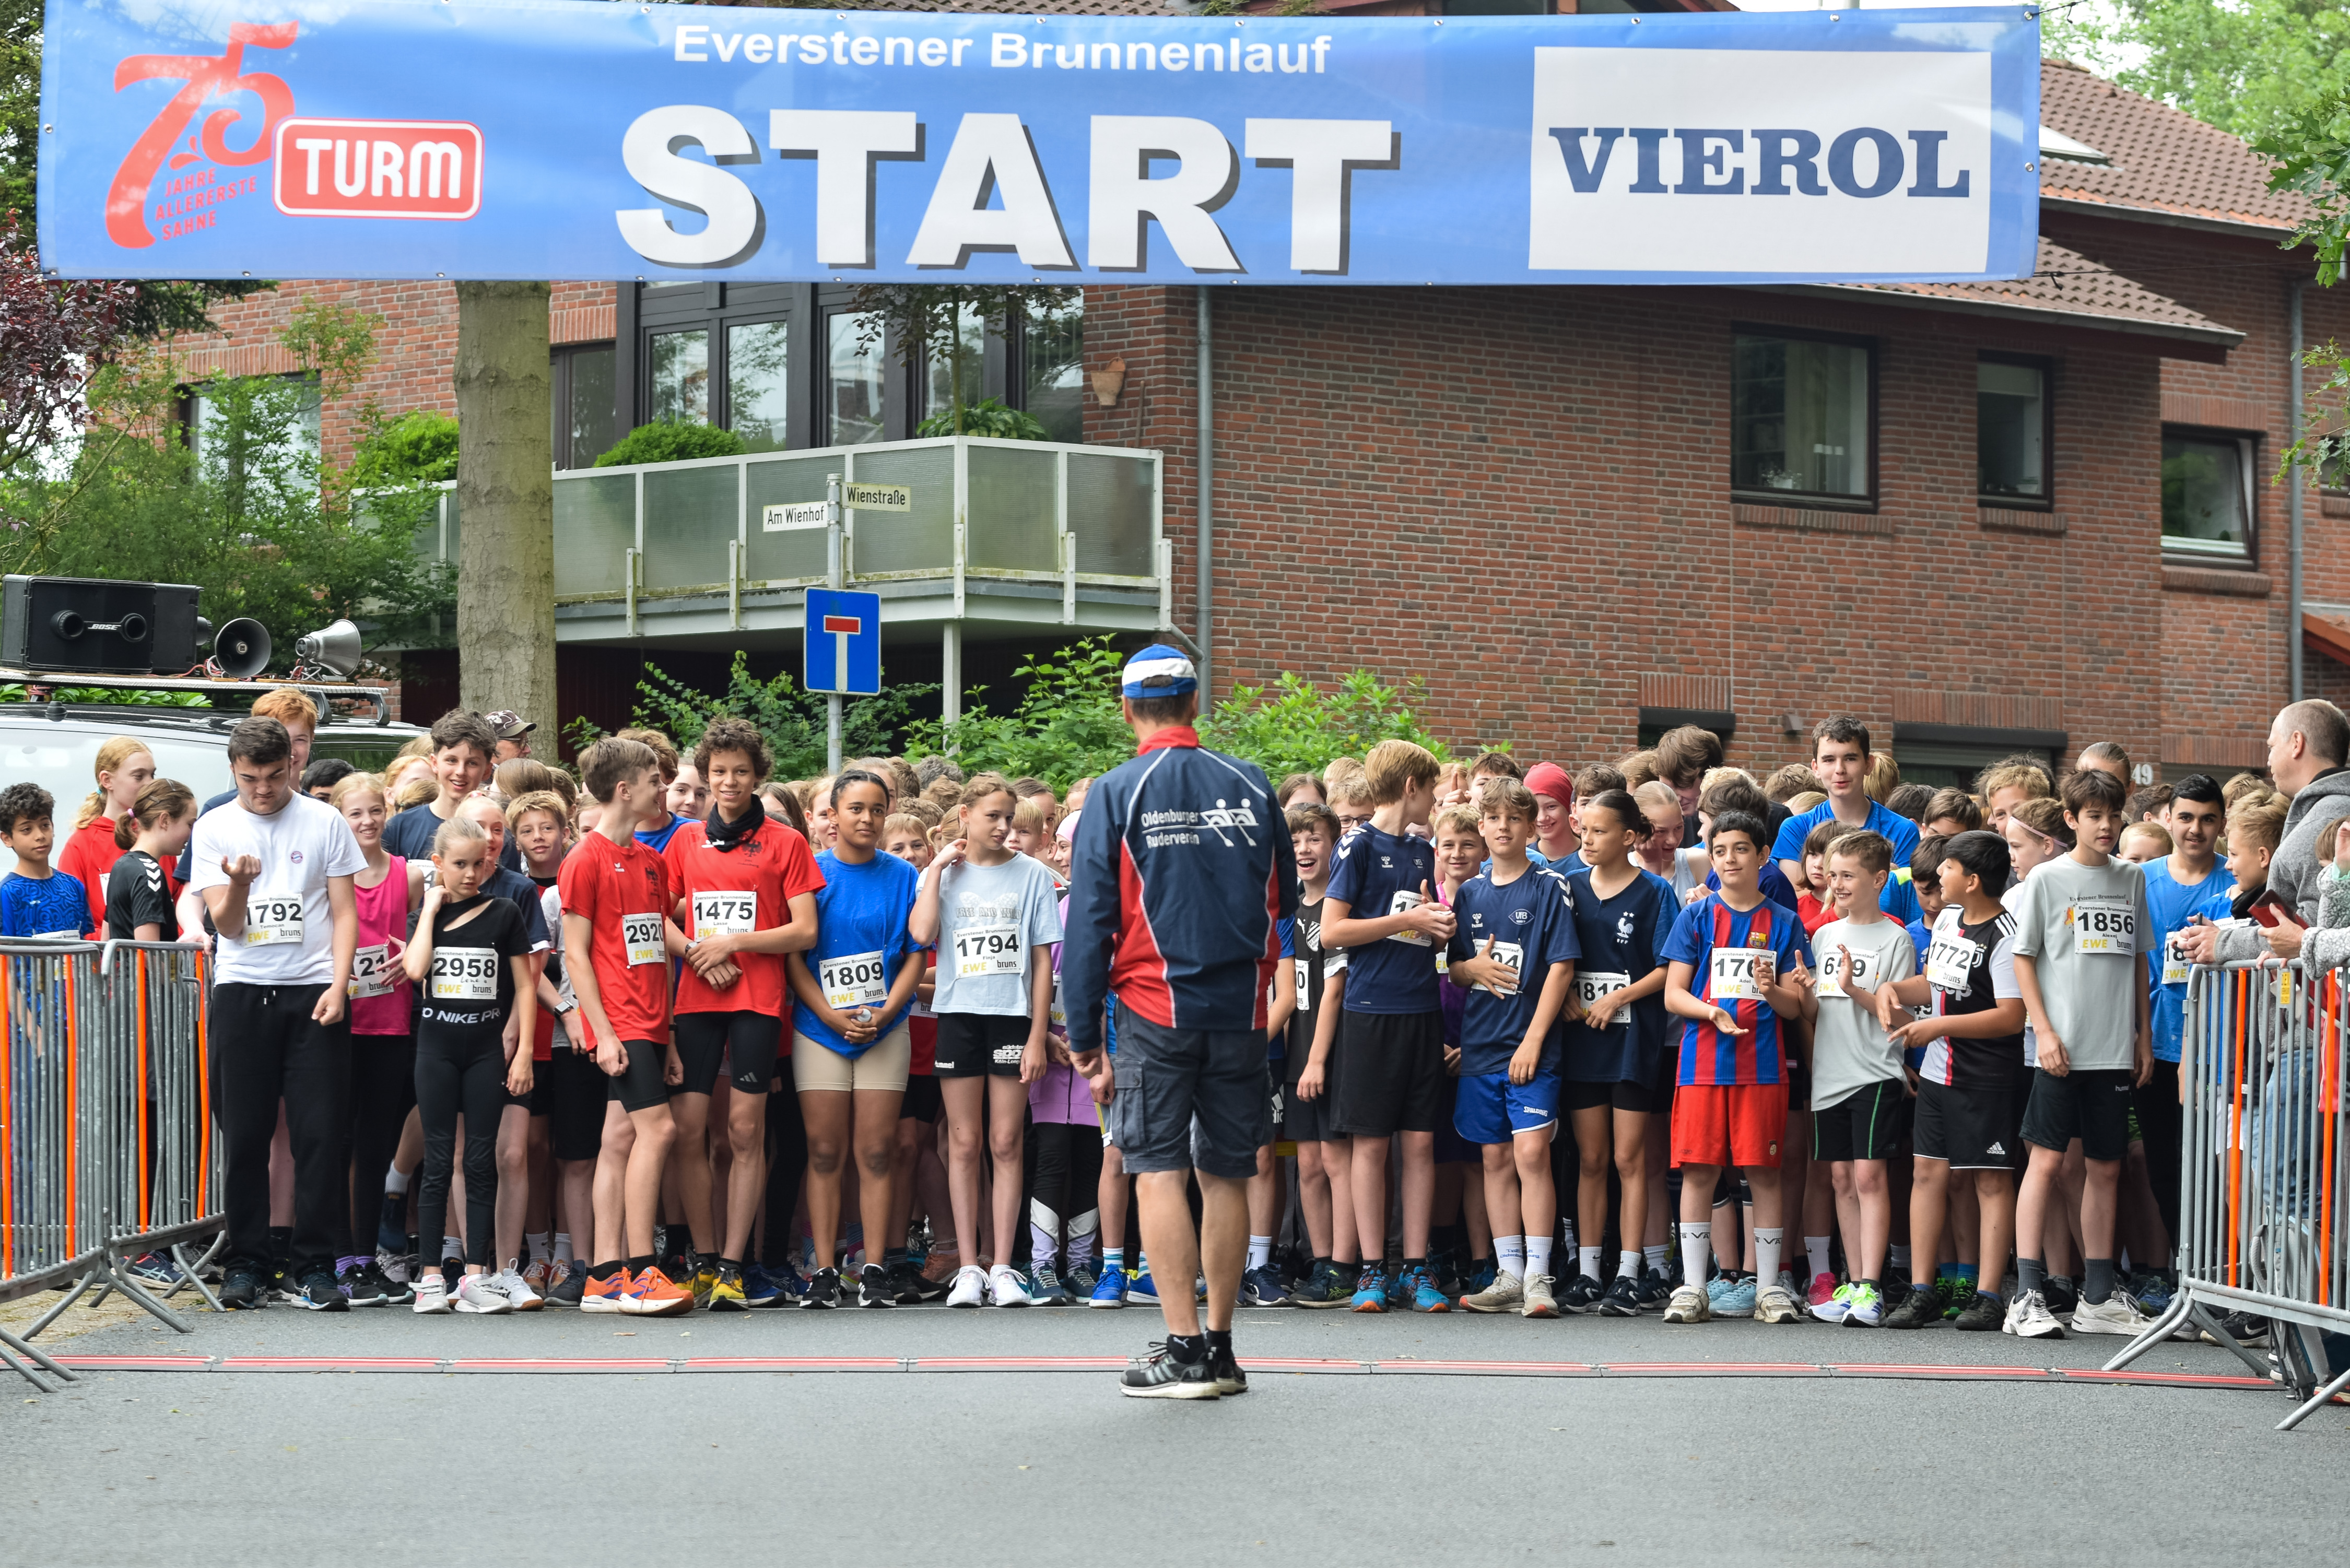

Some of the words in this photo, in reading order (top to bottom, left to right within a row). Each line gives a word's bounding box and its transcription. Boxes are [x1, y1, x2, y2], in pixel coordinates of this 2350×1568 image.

[673, 25, 973, 68] Everstener
[991, 33, 1331, 74] Brunnenlauf
[106, 20, 299, 249] 75
[296, 138, 462, 199] TURM
[1548, 126, 1970, 199] VIEROL
[164, 168, 216, 197] JAHRE
[616, 104, 1401, 276] START
[155, 176, 257, 221] ALLERERSTE
[162, 210, 217, 240] SAHNE
[847, 487, 906, 505] Wienstraße
[767, 510, 782, 524] Am
[785, 506, 824, 523] Wienhof
[2131, 763, 2153, 785] 49
[1141, 809, 1199, 828] Oldenburger
[247, 903, 303, 926] 1792
[695, 902, 753, 921] 1475
[956, 907, 975, 918] FREE
[979, 907, 997, 917] AND
[698, 927, 718, 937] EWE
[2078, 912, 2134, 935] 1856
[248, 930, 269, 942] EWE
[626, 923, 663, 944] 2920
[635, 949, 653, 959] EWE
[957, 934, 1019, 957] 1794
[2083, 939, 2108, 948] EWE
[2117, 939, 2132, 950] bruns
[851, 955, 881, 963] Brunnenlauf
[1931, 941, 1970, 970] 1772
[433, 958, 496, 978] 2958
[824, 961, 884, 988] 1809
[962, 962, 987, 973] EWE
[1819, 983, 1836, 992] EWE
[1943, 972, 1961, 984] bruns
[437, 984, 462, 993] EWE
[473, 984, 491, 993] bruns
[830, 992, 855, 1005] EWE
[864, 988, 884, 997] bruns
[1718, 984, 1742, 994] EWE
[436, 1010, 479, 1023] NIKE
[481, 1008, 500, 1022] PR
[1523, 1106, 1548, 1117] SPALDING
